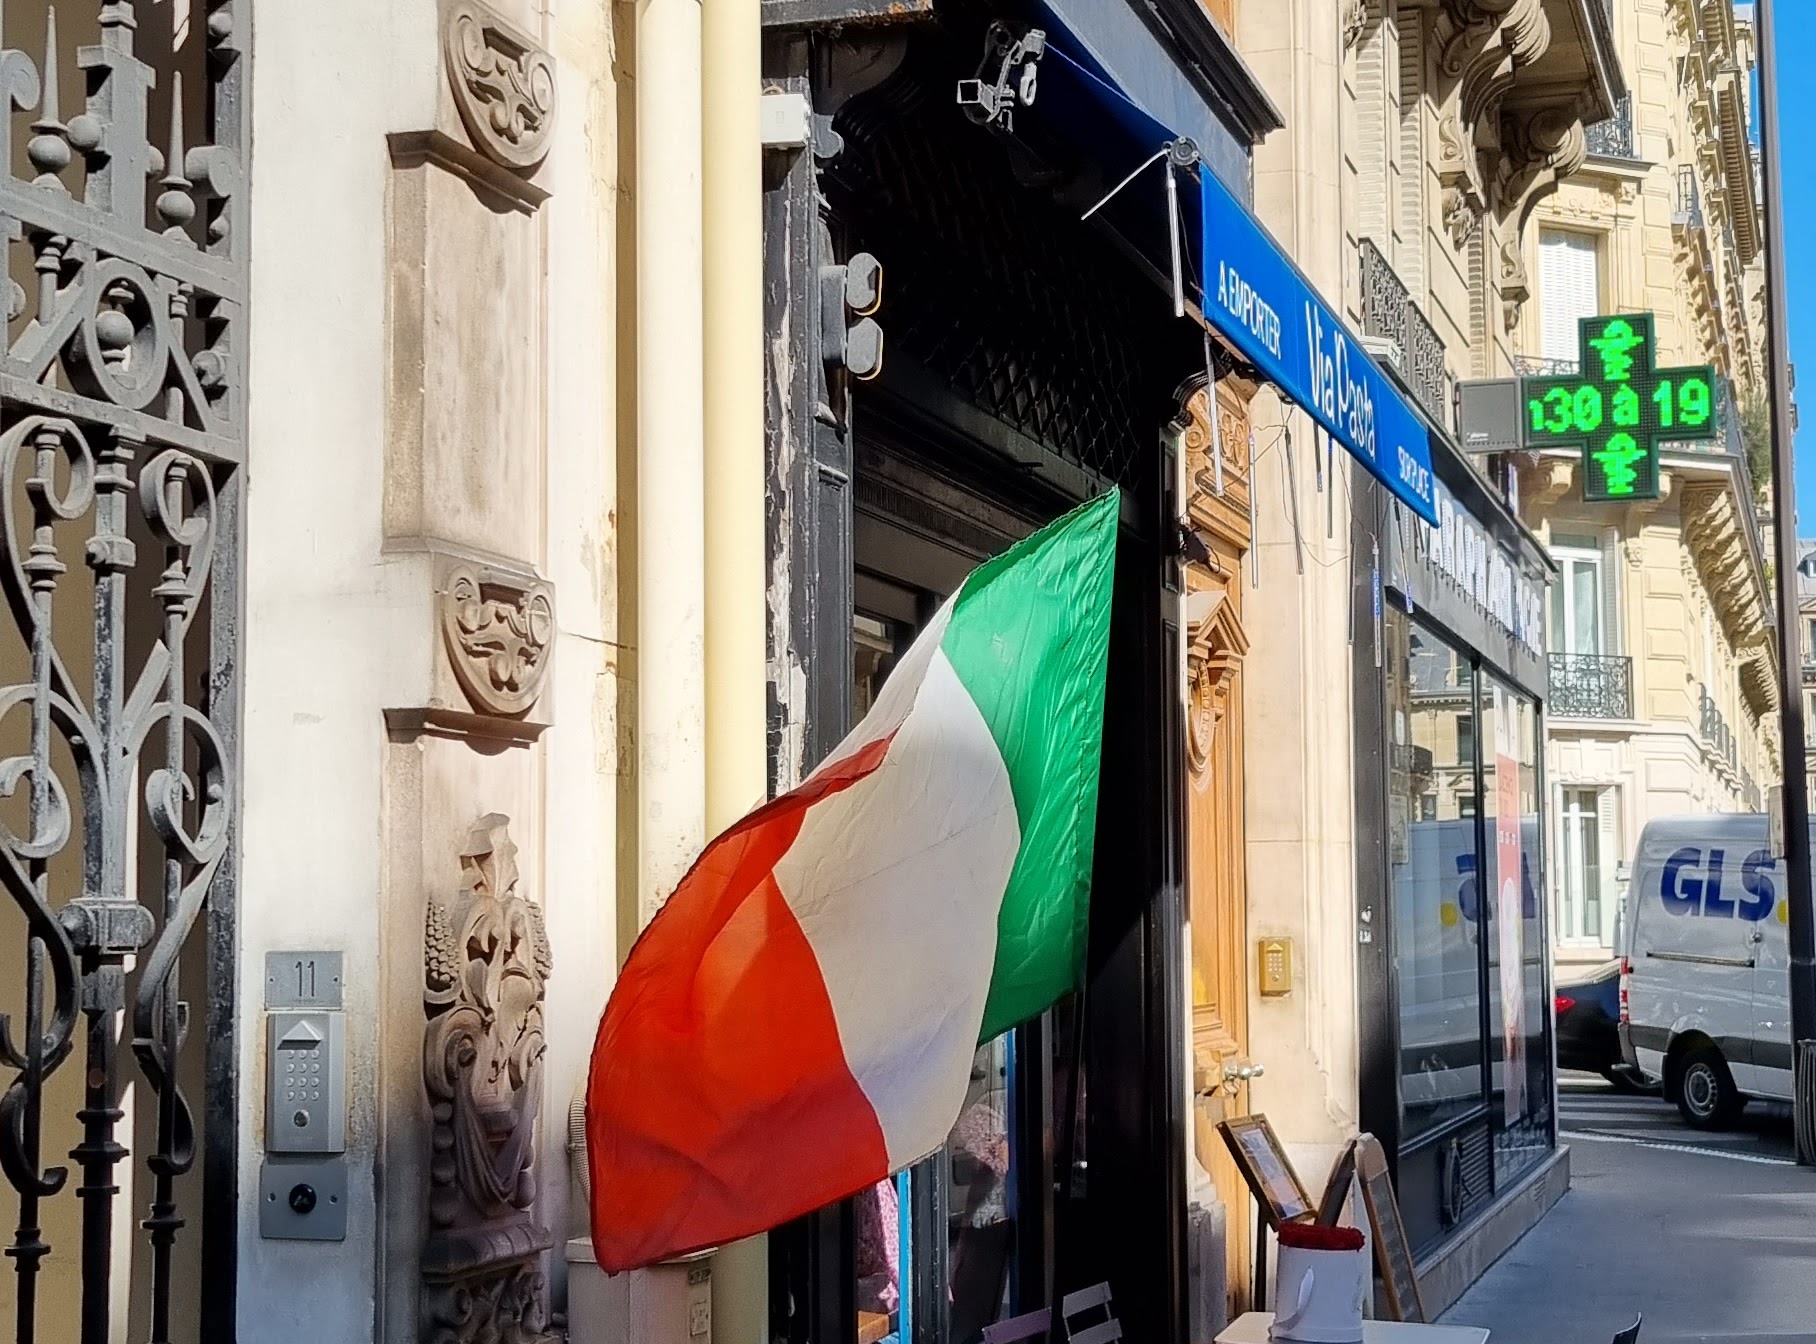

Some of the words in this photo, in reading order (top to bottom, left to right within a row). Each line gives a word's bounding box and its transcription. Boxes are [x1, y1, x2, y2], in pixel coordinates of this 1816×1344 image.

[1217, 259, 1228, 308] A
[1228, 267, 1282, 361] EMPORTER
[1305, 299, 1335, 425] Via
[1334, 329, 1376, 461] Pasta
[1612, 383, 1640, 427] à
[1653, 378, 1711, 428] 19
[1660, 846, 1777, 923] GLS
[295, 960, 315, 997] 11
